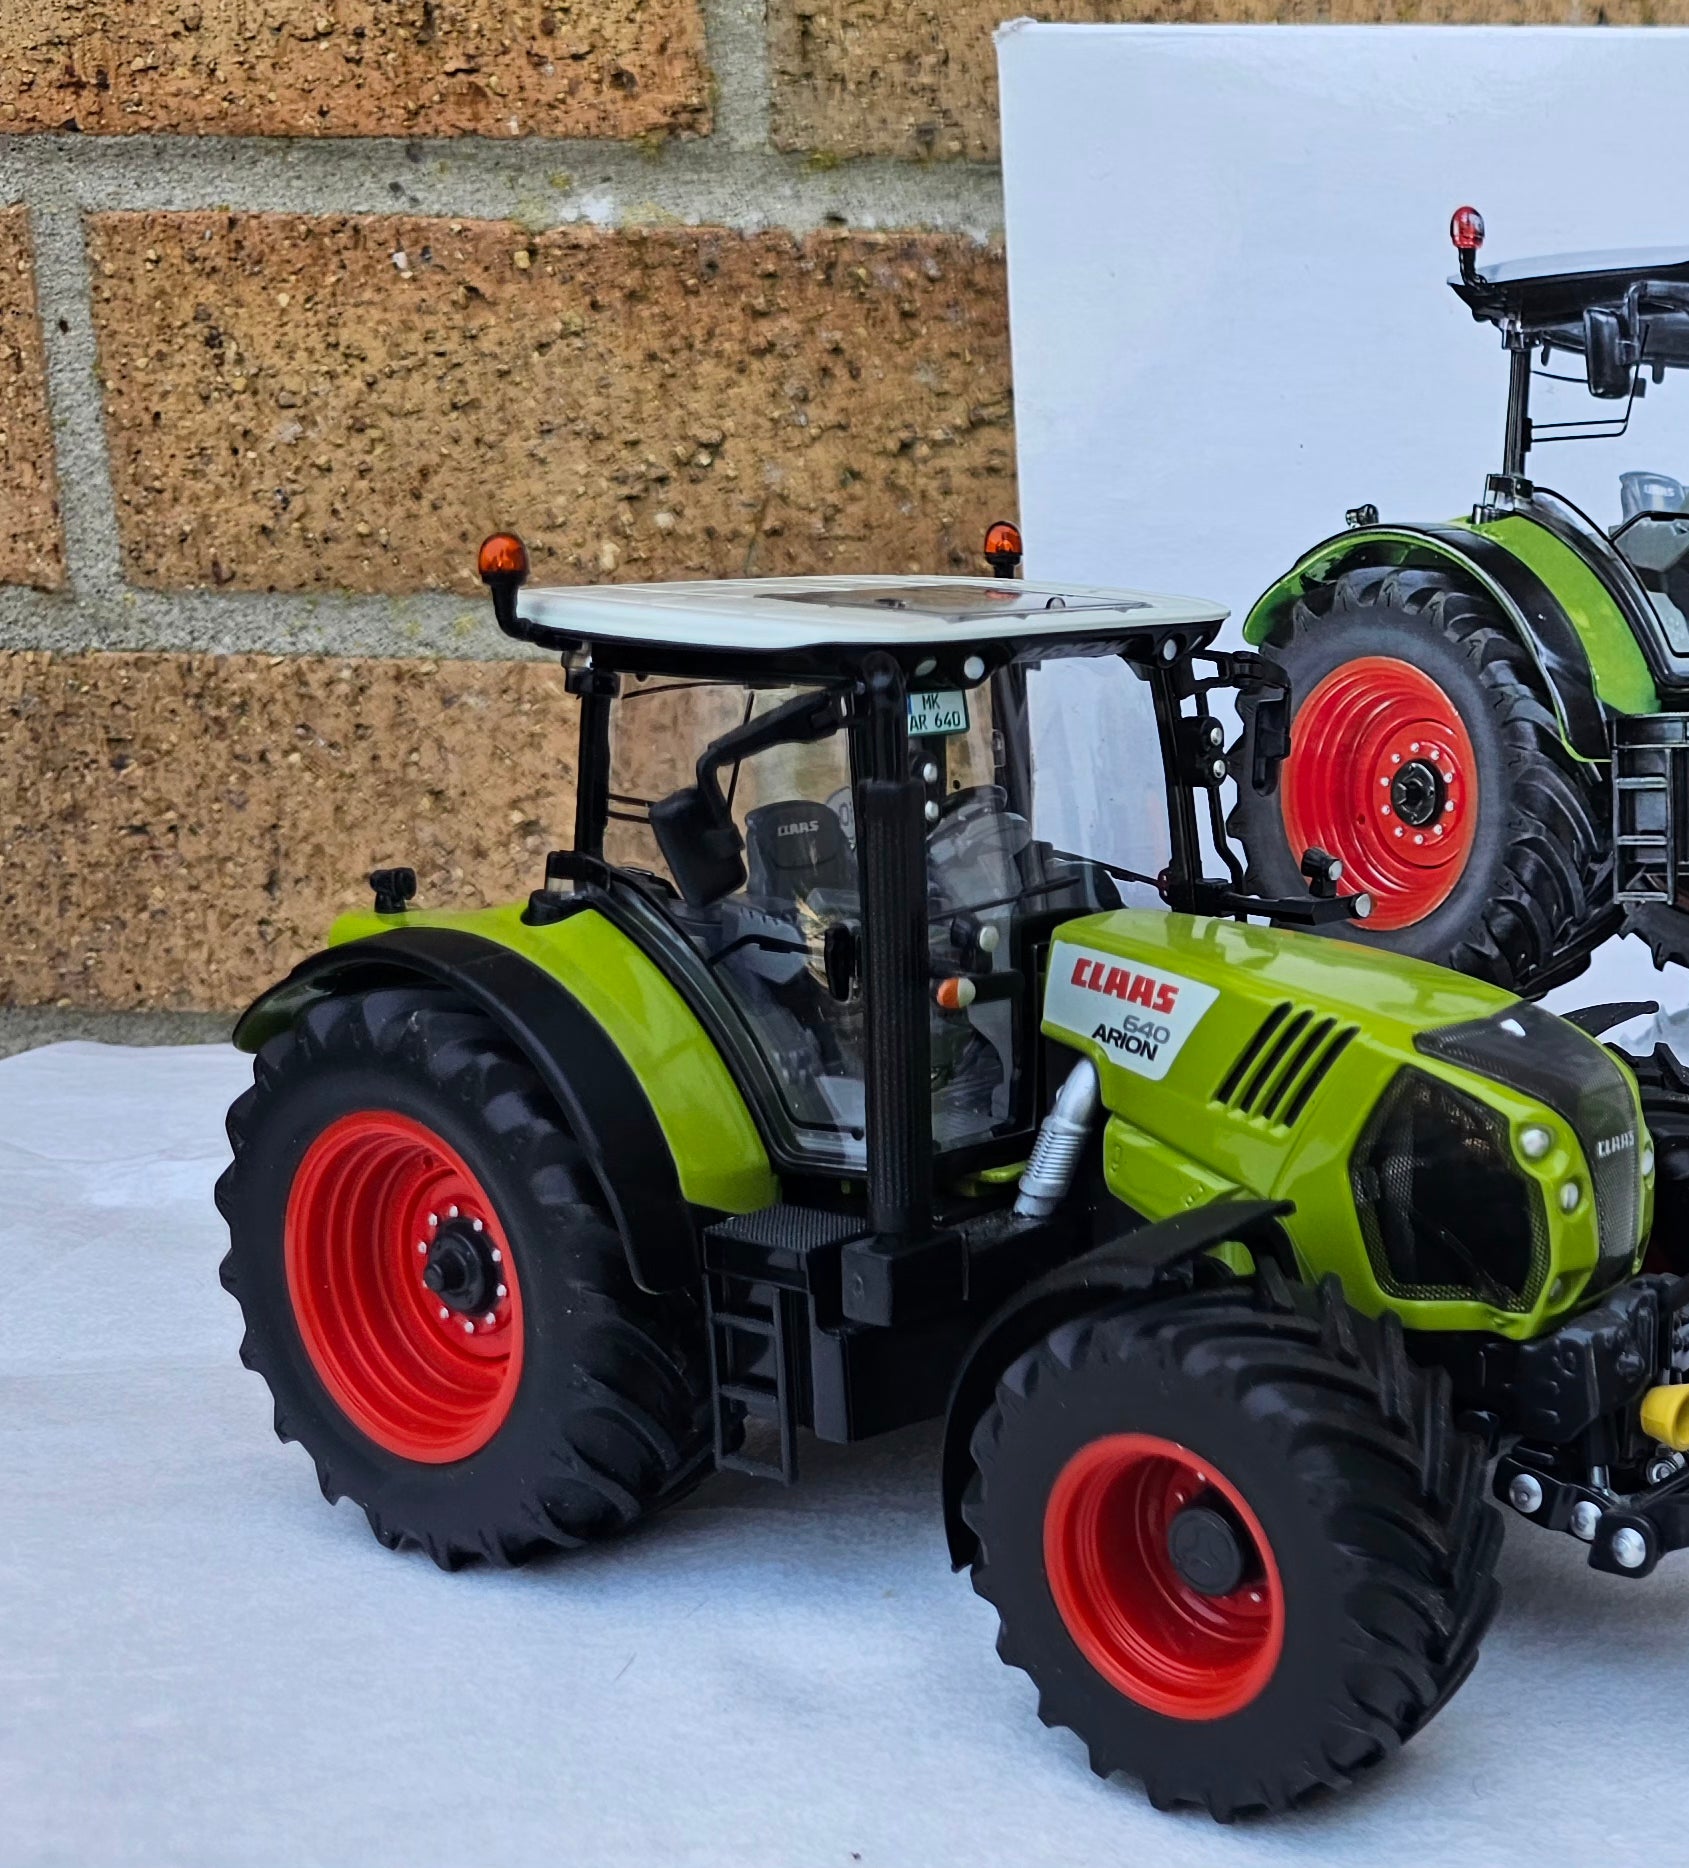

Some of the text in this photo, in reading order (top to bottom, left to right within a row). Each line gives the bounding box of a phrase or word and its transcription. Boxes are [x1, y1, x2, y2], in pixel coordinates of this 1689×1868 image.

[922, 693, 941, 711] MK
[909, 711, 961, 732] AR 640
[777, 820, 820, 837] CLAAS
[1070, 957, 1180, 1015] CLAAS
[1091, 1023, 1159, 1062] ARION
[1123, 1014, 1171, 1044] 640
[1598, 1130, 1635, 1158] CLAAS
